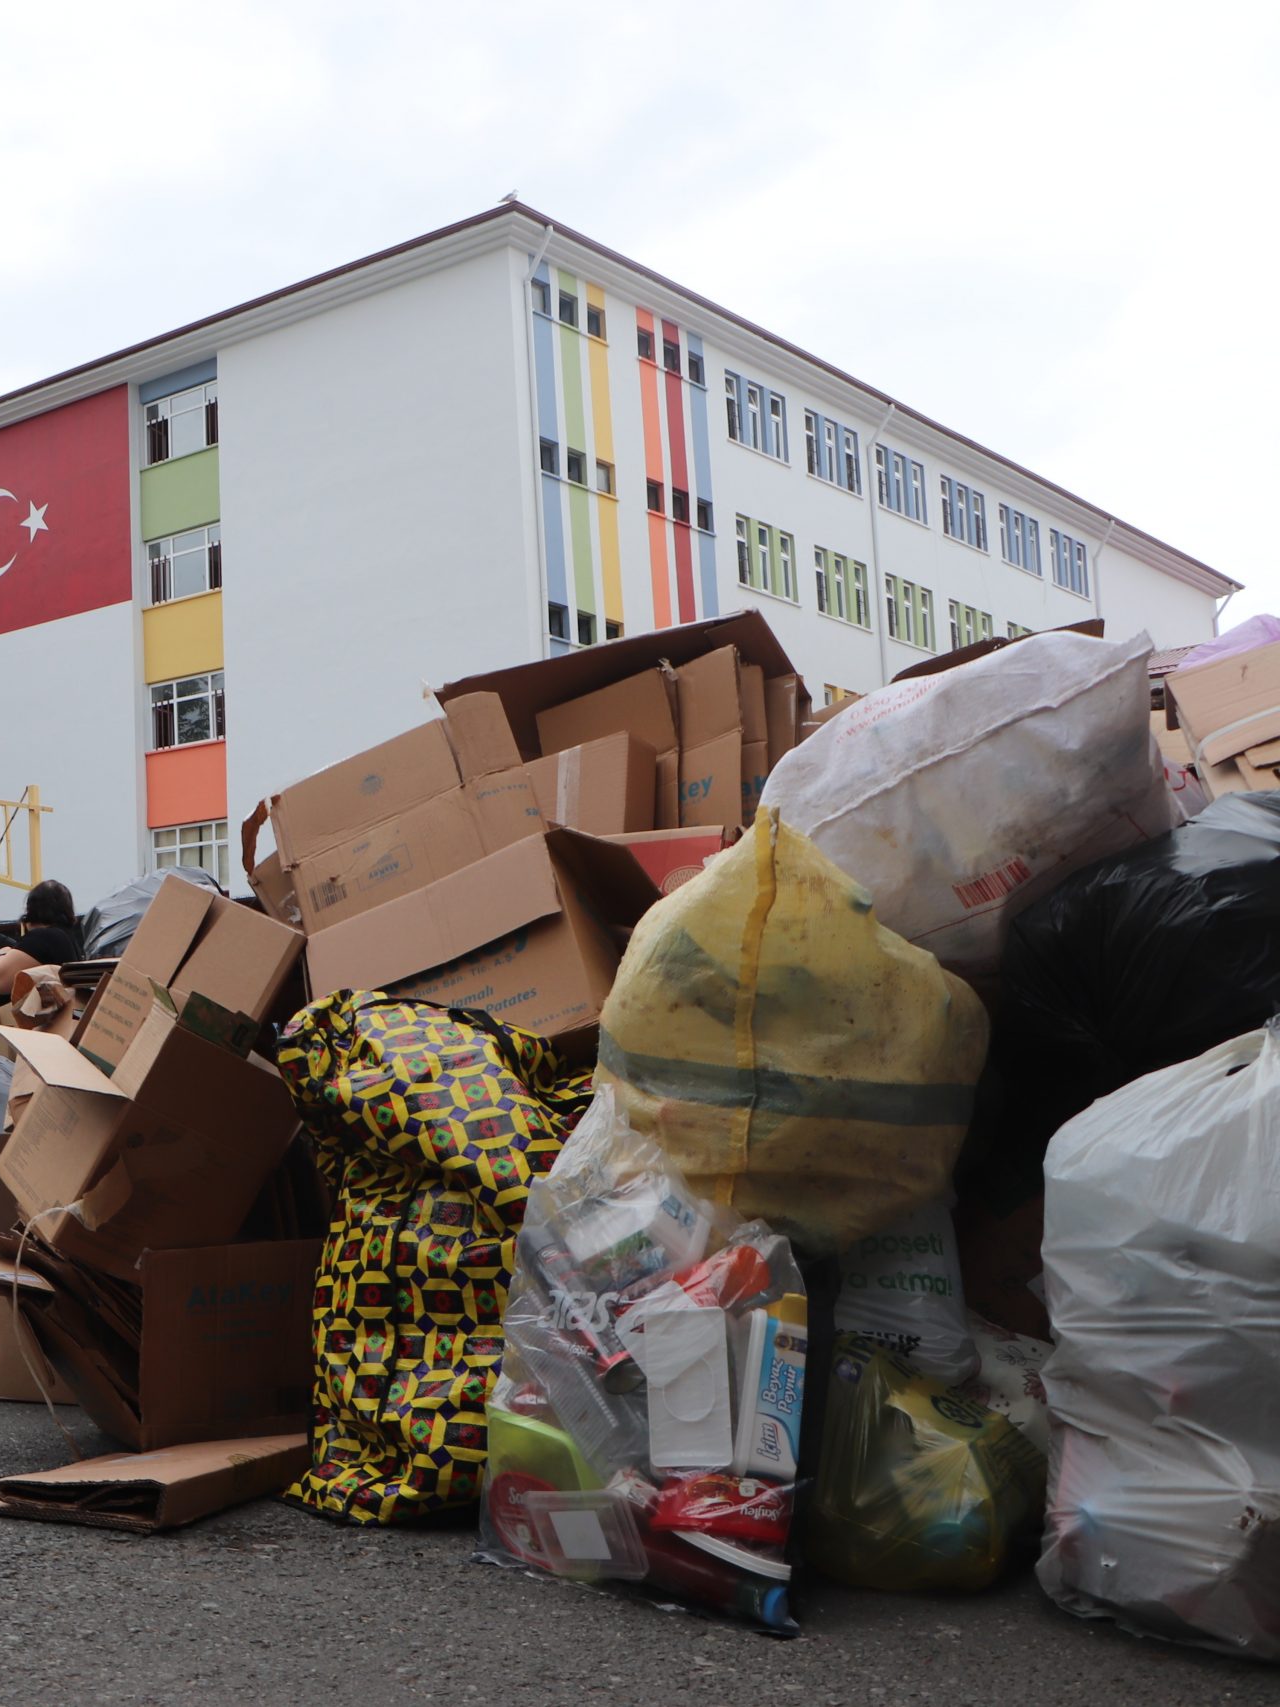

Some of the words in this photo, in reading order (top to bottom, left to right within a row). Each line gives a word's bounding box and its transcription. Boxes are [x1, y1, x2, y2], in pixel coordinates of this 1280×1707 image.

[861, 1231, 944, 1261] poşeti
[762, 1358, 785, 1404] Beyaz
[777, 1366, 797, 1413] Peynir
